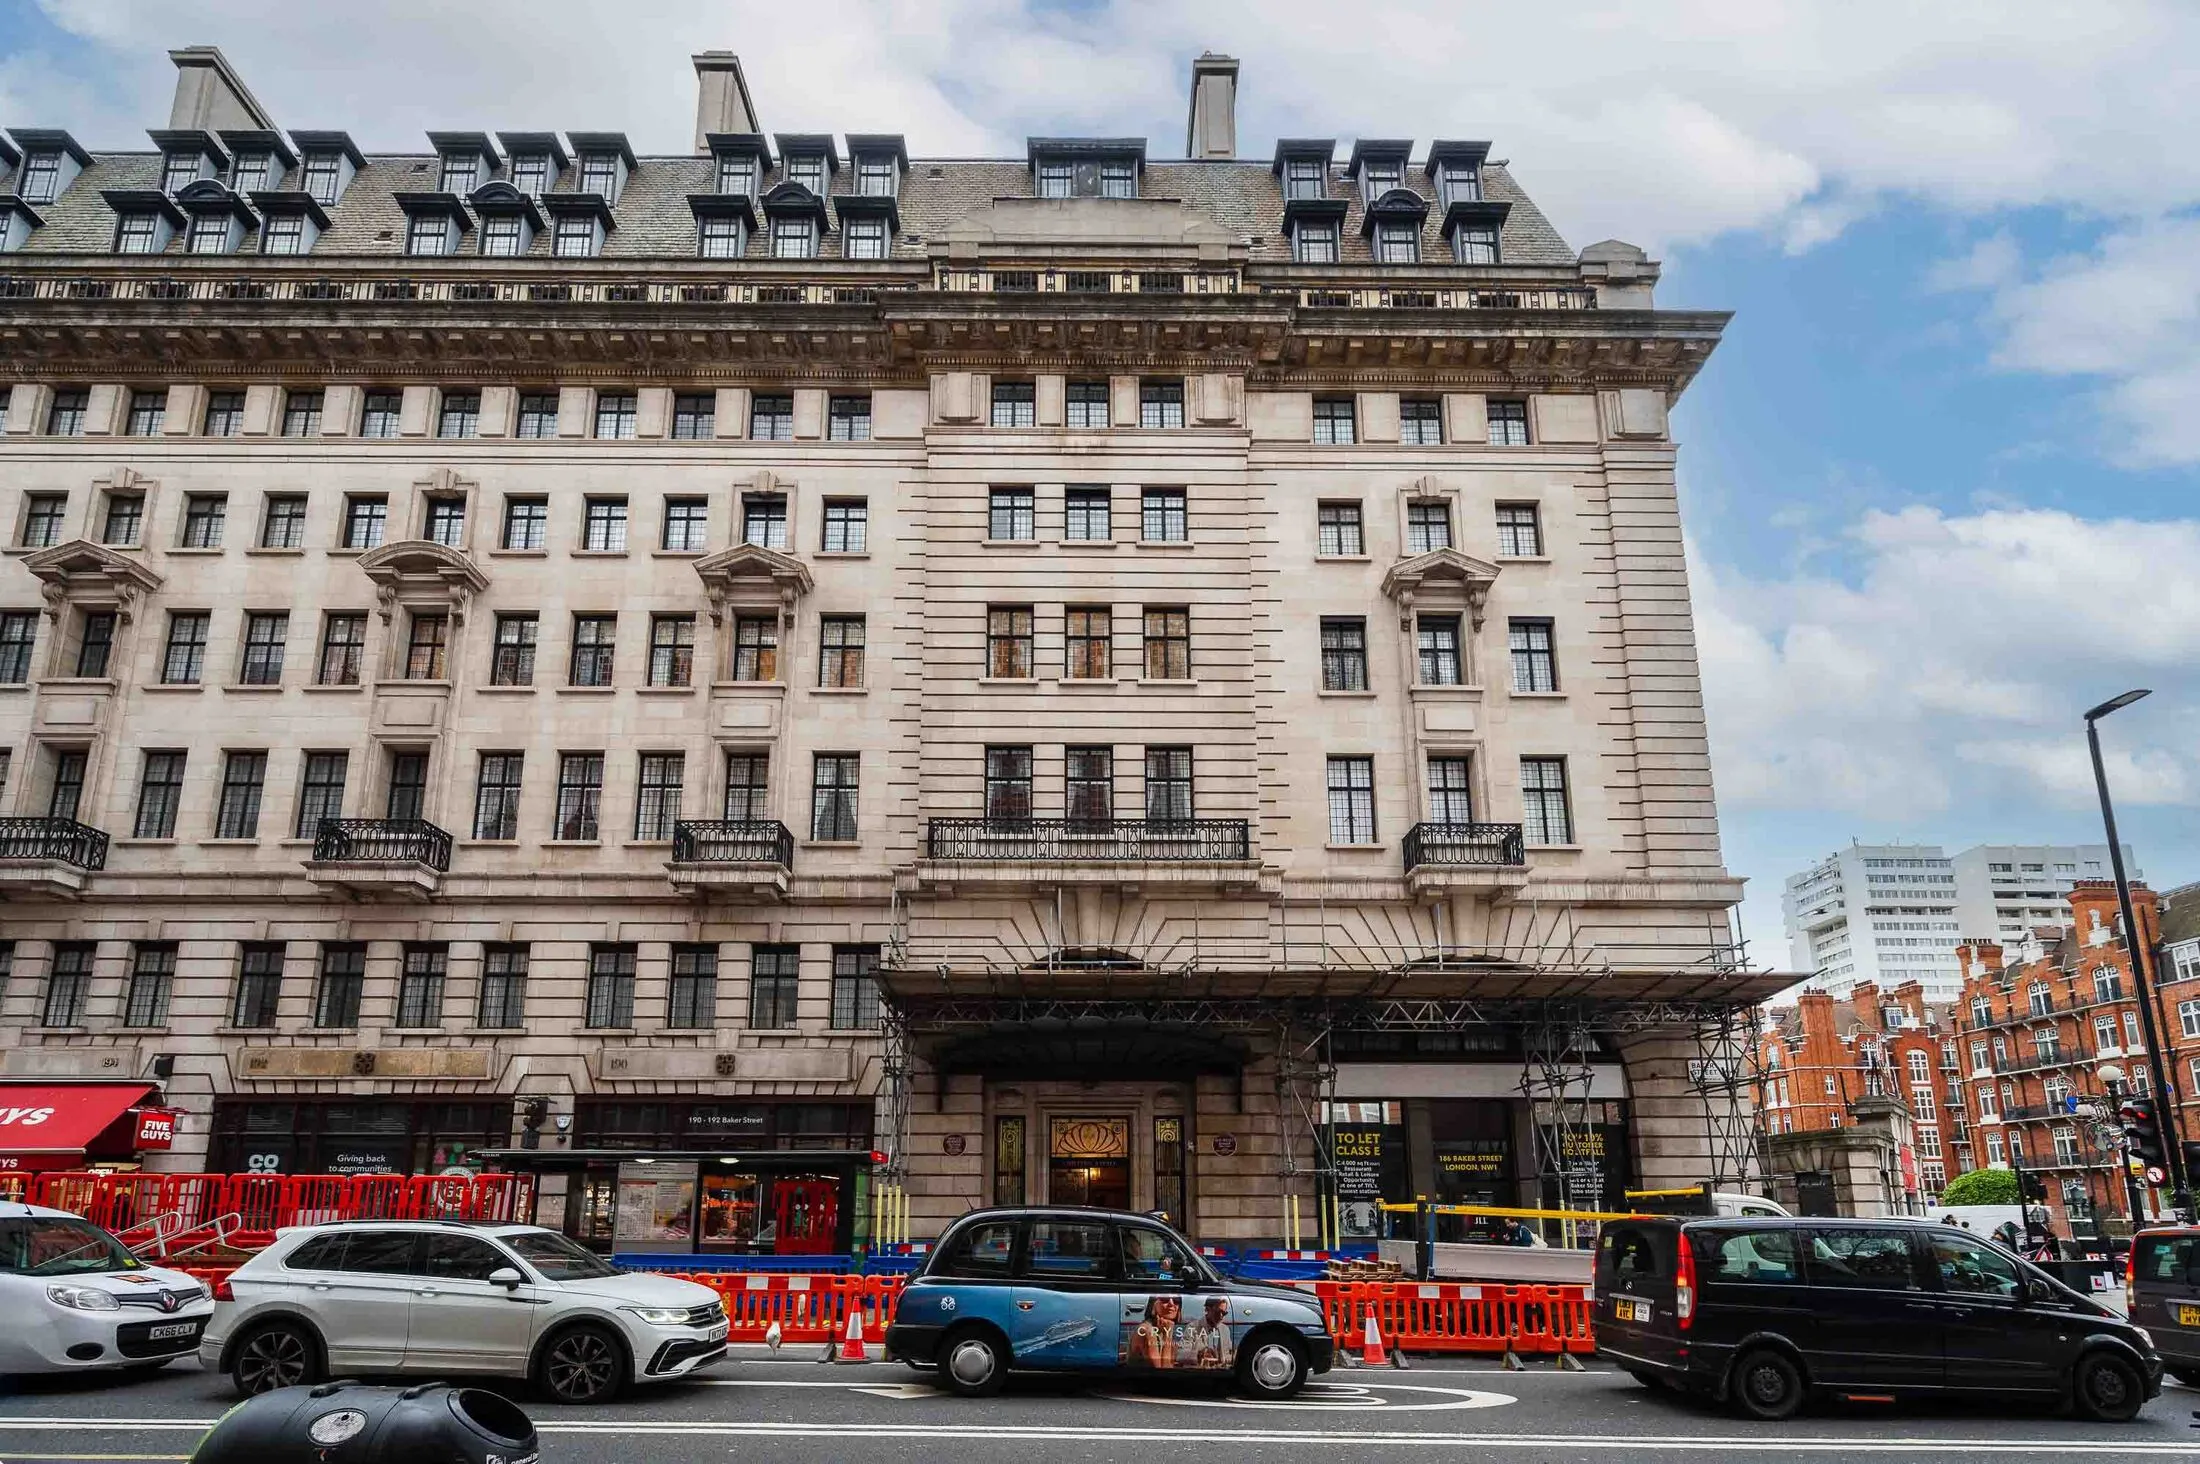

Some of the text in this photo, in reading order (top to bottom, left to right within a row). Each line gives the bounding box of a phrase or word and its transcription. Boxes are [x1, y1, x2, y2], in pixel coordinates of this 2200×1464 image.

[145, 1121, 170, 1131] FIVE
[140, 1130, 172, 1141] GUYS
[1336, 1133, 1381, 1144] TO LET
[1336, 1146, 1381, 1156] CLASS E
[249, 1154, 279, 1168] CO
[337, 1154, 386, 1164] Giving back
[329, 1163, 392, 1173] to communities
[1474, 1217, 1489, 1225] JLL
[153, 1324, 194, 1338] CK66 CLV
[1137, 1326, 1220, 1339] CRYSTAL
